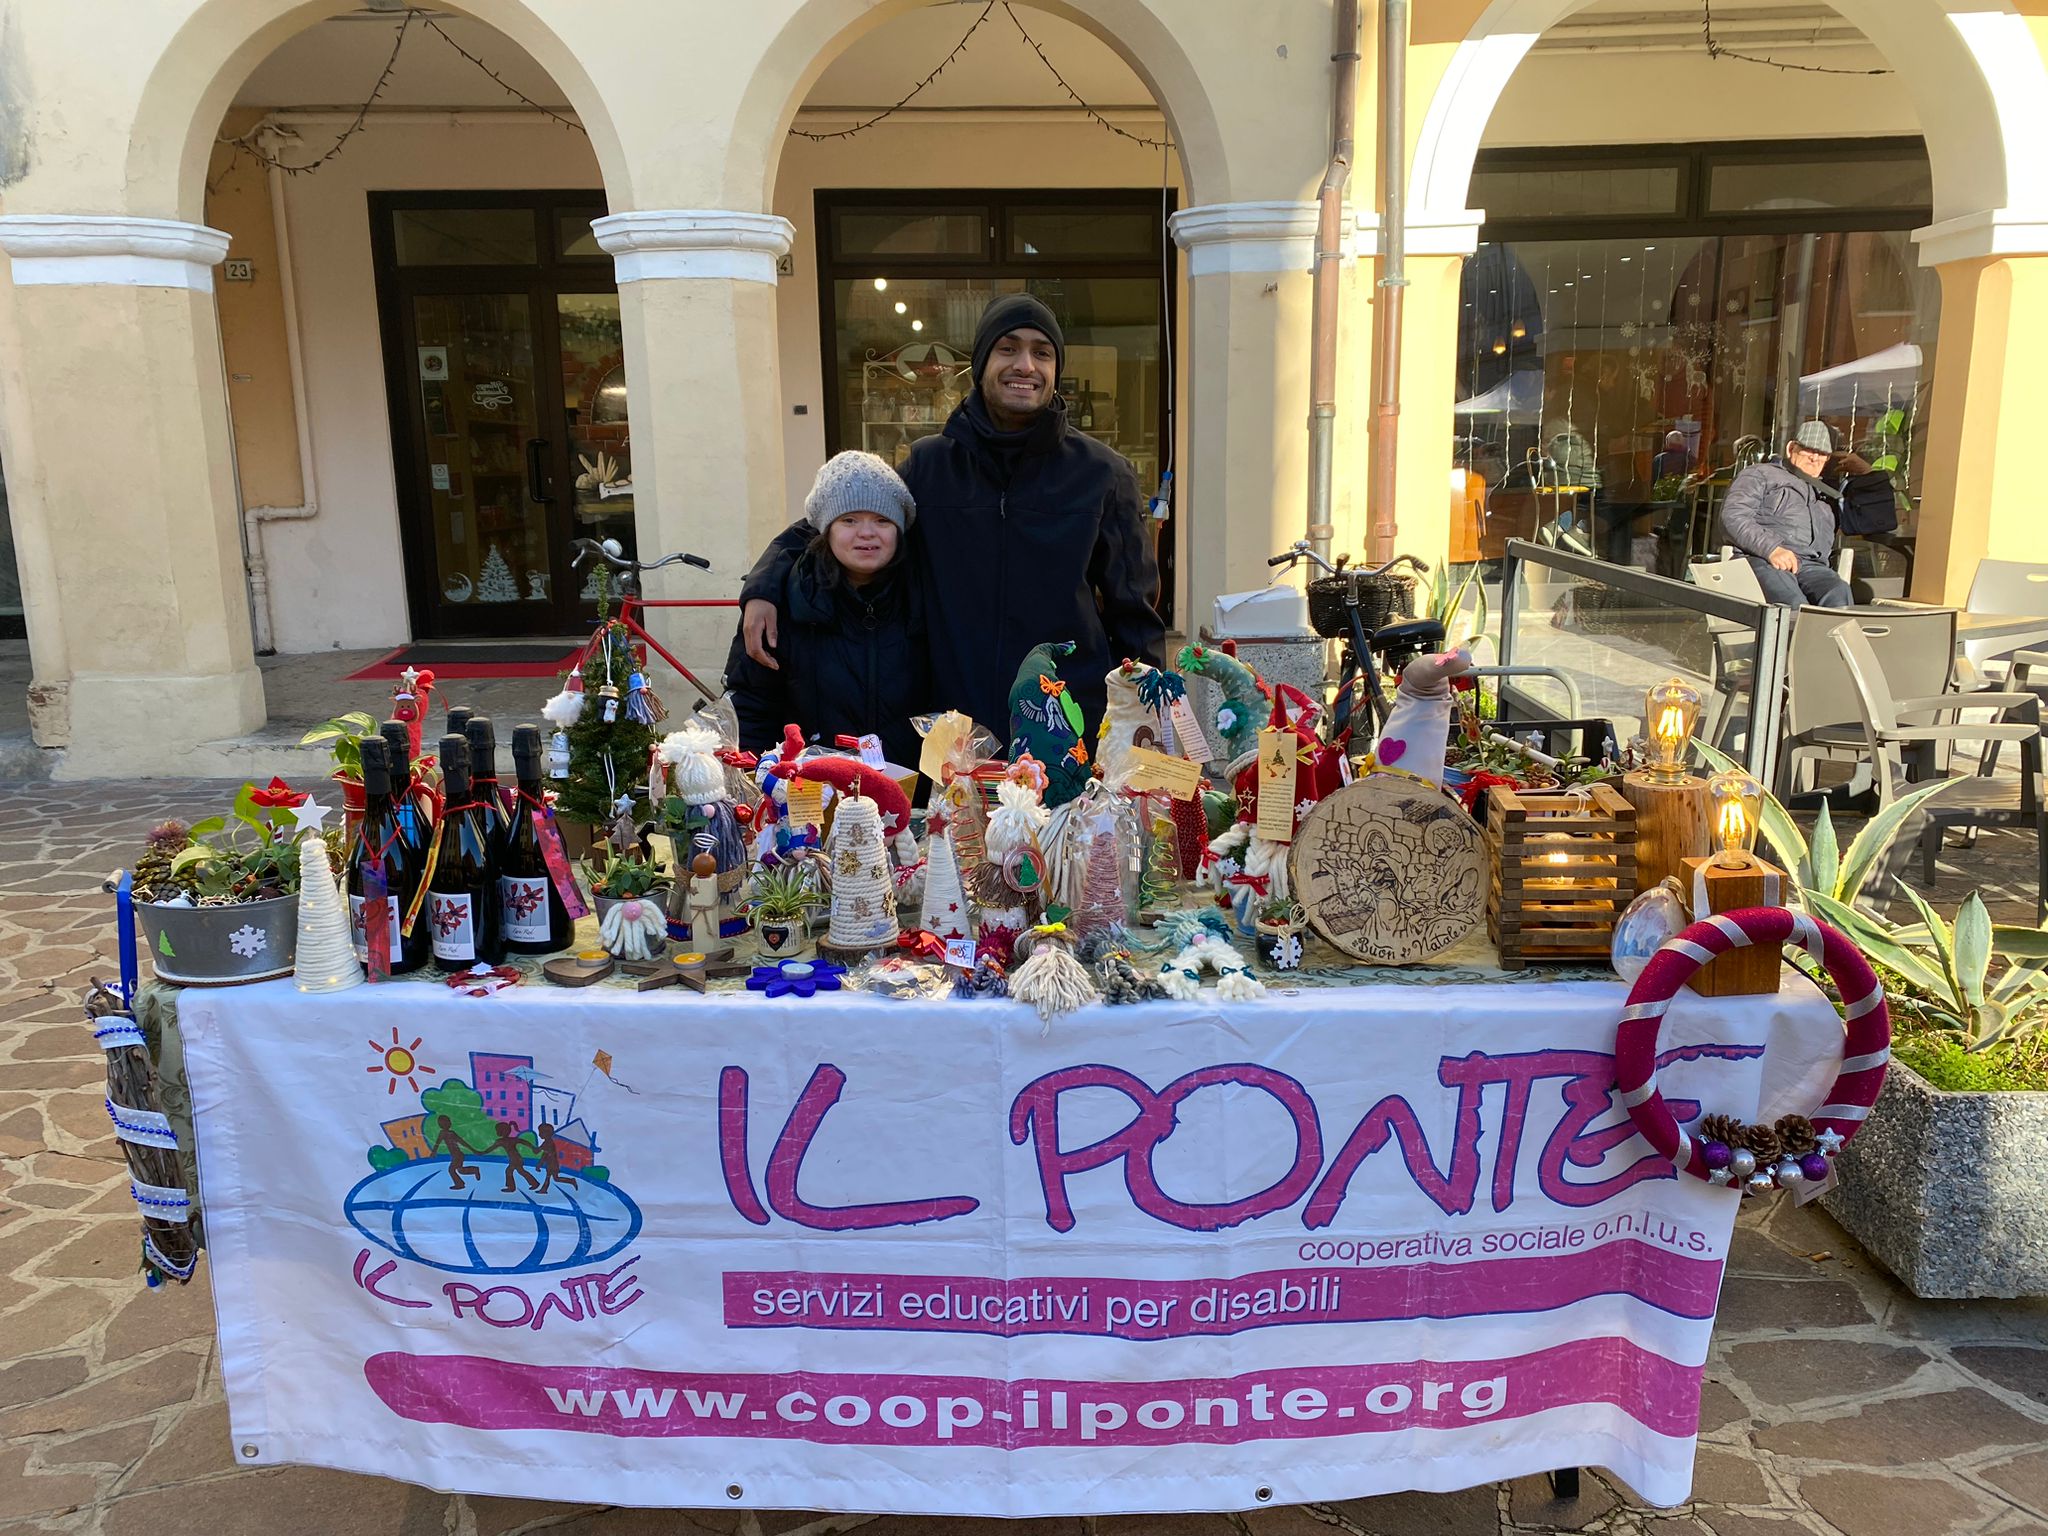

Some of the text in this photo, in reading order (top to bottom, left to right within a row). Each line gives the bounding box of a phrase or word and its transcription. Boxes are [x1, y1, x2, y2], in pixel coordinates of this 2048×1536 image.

[230, 264, 248, 277] 23
[1356, 925, 1460, 960] Buon Natale
[718, 1044, 1766, 1233] IL PONTE
[1299, 1211, 1713, 1266] cooperativa sociale o.n.l.u.s.
[353, 1248, 645, 1331] IL PONTE
[752, 1276, 1341, 1332] servizi educativi per disabili
[543, 1376, 1508, 1440] www.coop-ilponte.org
